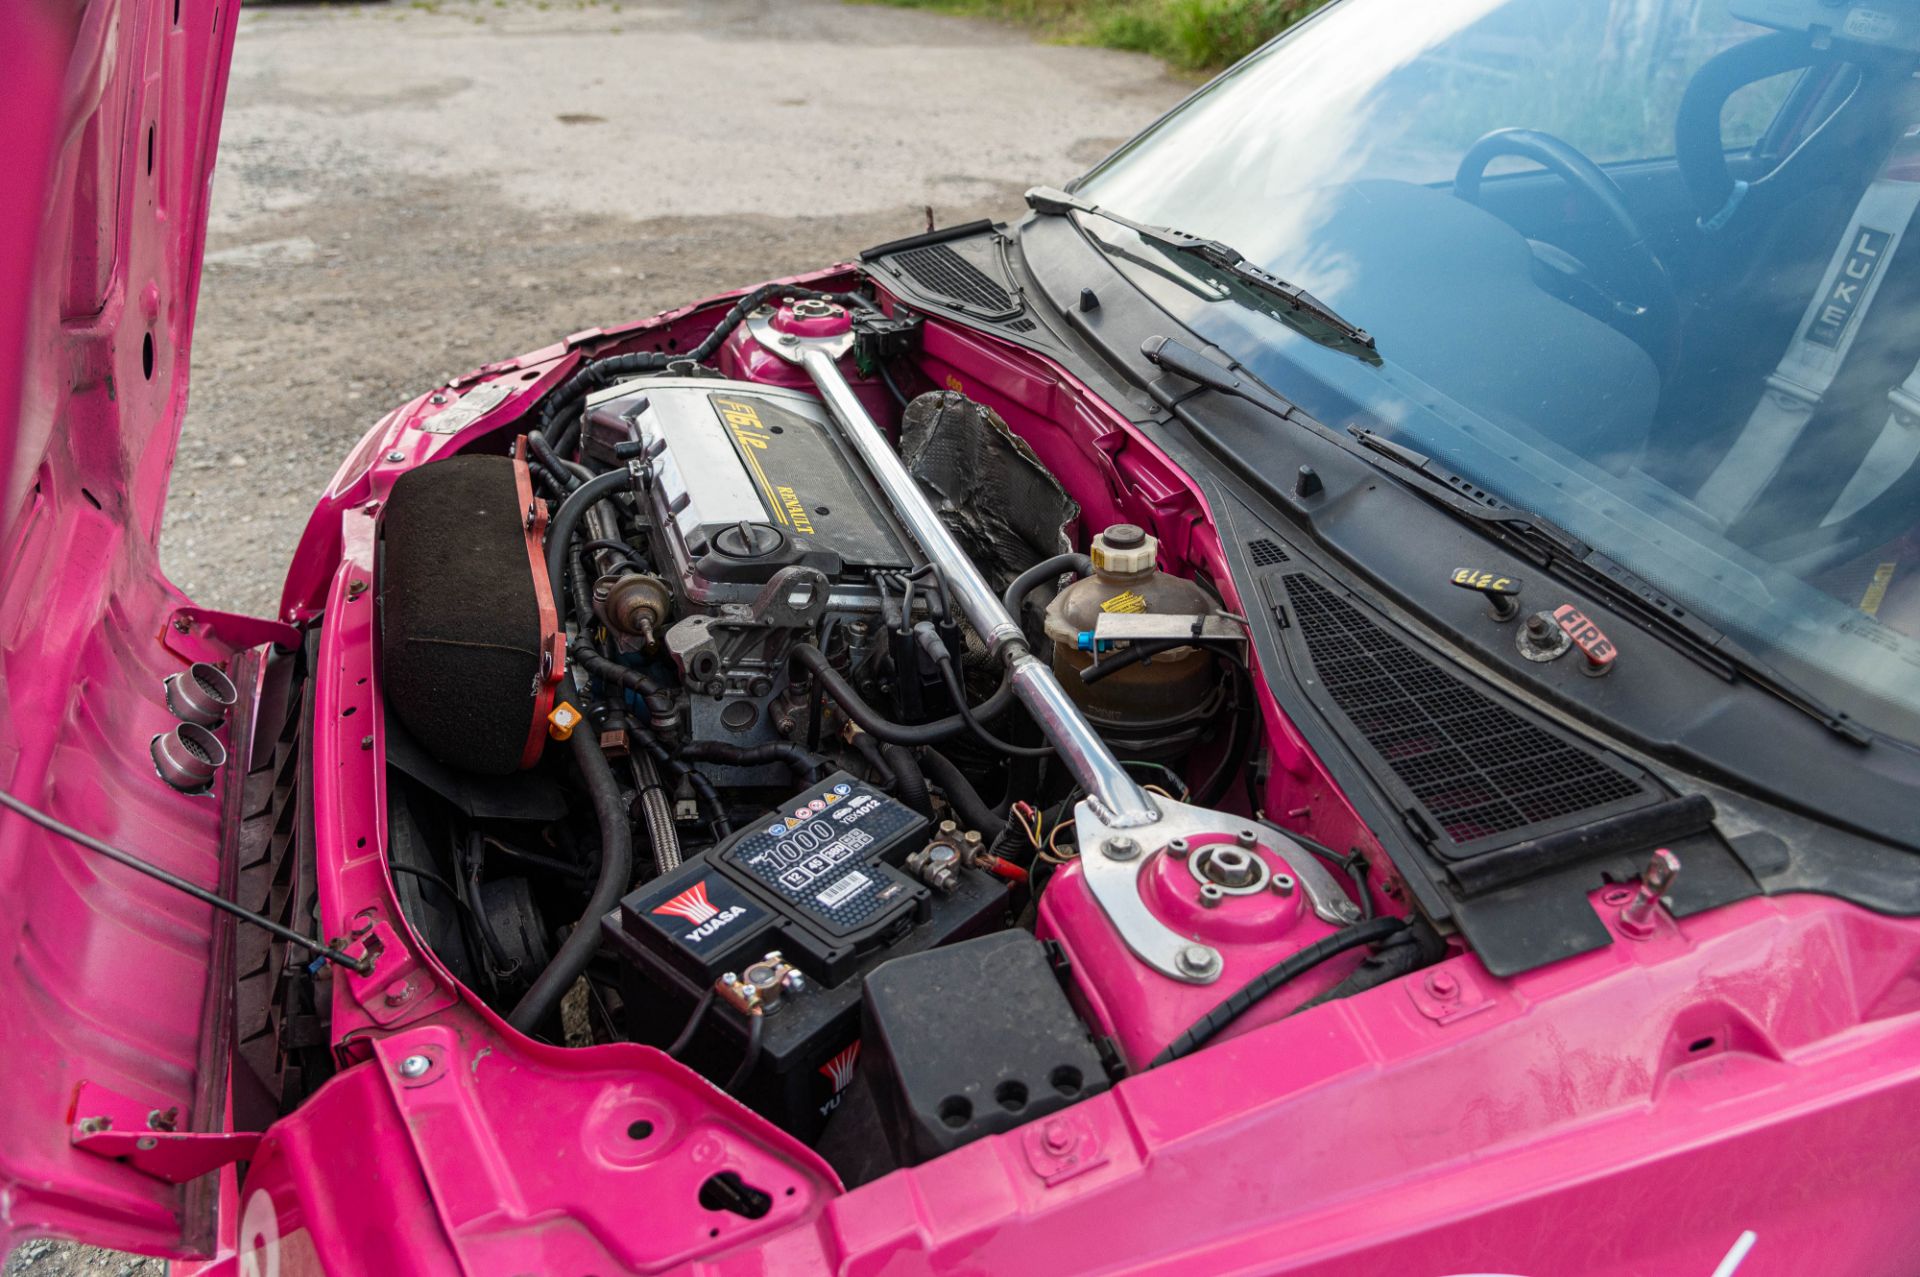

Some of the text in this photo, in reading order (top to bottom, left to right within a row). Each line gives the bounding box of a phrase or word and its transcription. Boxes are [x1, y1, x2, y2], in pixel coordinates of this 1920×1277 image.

[1820, 233, 1876, 326] LUKE
[777, 485, 815, 534] RENAULT
[1455, 570, 1510, 590] ELEC
[1560, 610, 1612, 657] FIRE
[840, 799, 880, 825] YBX1012
[808, 858, 823, 869] 45
[787, 872, 801, 882] 12
[685, 905, 747, 942] YUASA
[819, 1090, 846, 1116] YU
